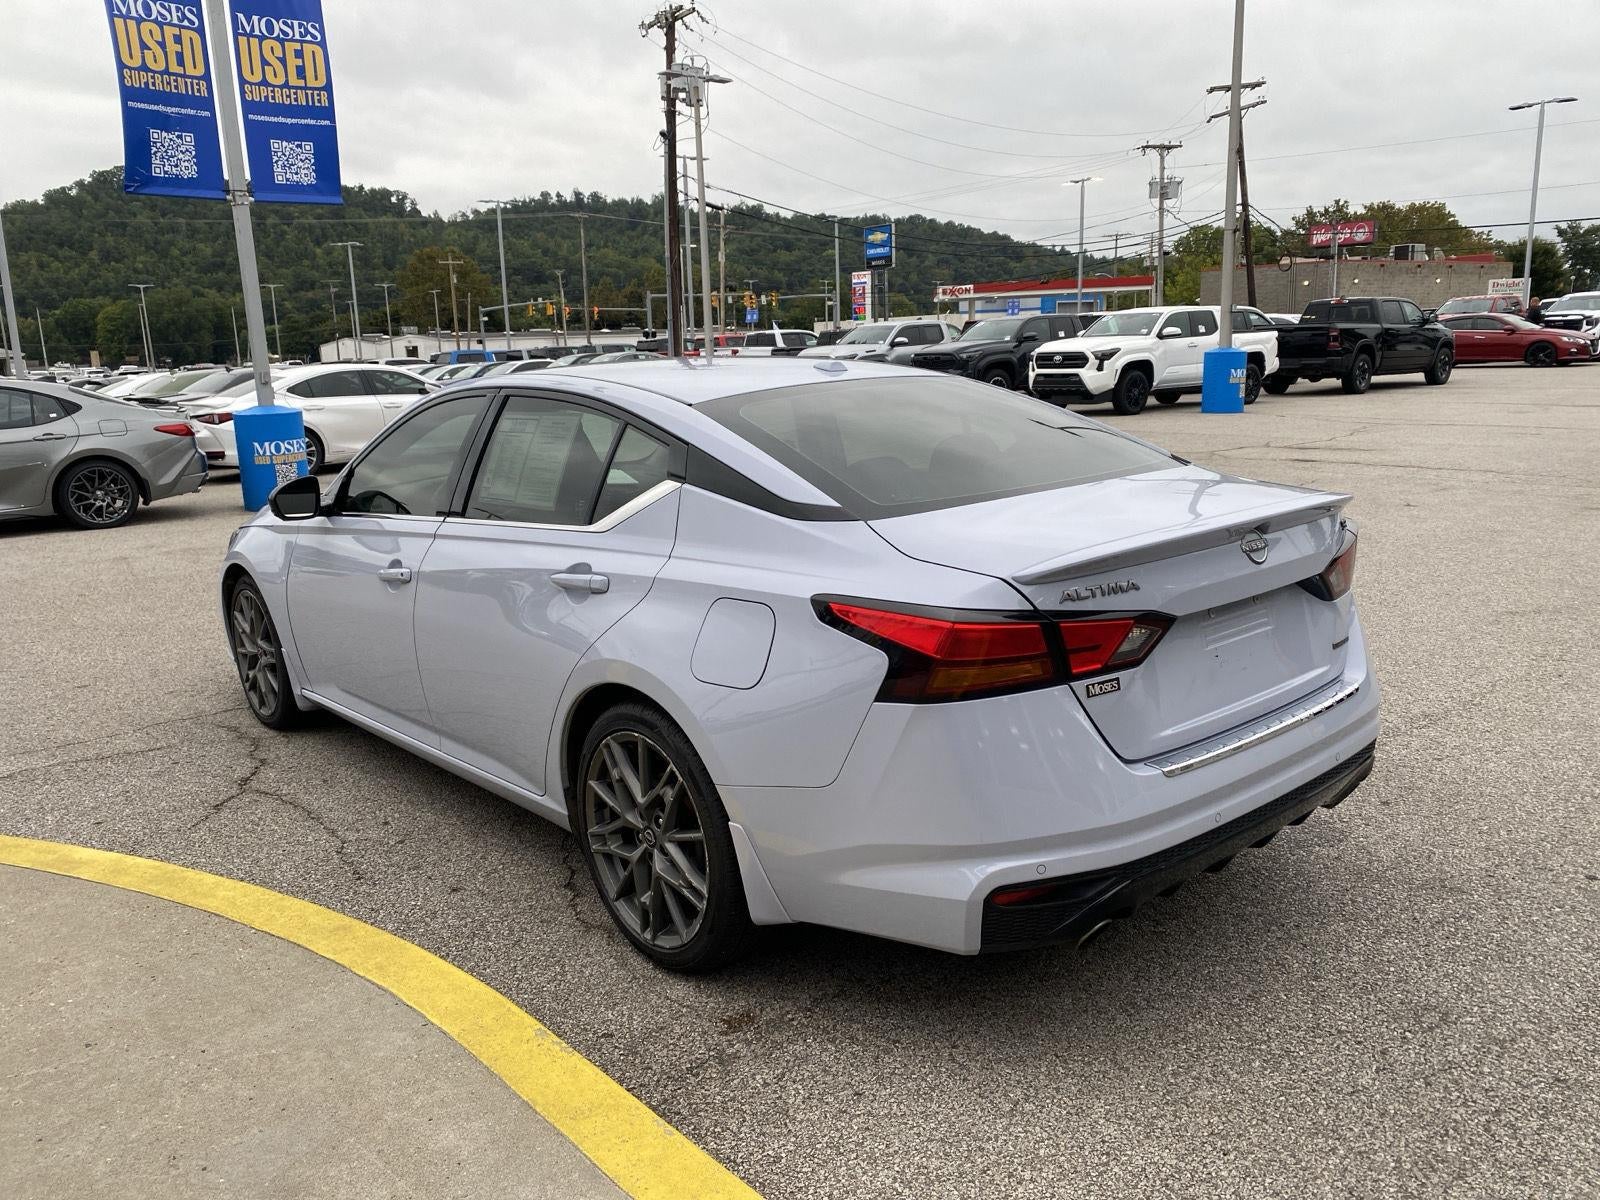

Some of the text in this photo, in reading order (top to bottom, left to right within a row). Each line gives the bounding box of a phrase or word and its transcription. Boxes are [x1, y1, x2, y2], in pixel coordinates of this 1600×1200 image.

[113, 0, 198, 27] MOSES
[236, 13, 321, 42] MOSES
[114, 17, 205, 77] USED
[238, 36, 327, 88] USED
[123, 69, 208, 97] SUPERCENTER
[244, 85, 329, 107] SUPERCENTER
[127, 101, 211, 117] mosesusedsupercenter.com
[248, 113, 331, 126] mosesusedsupercenter.com
[941, 286, 972, 298] EXXON
[253, 439, 305, 456] MOSES
[1059, 580, 1140, 604] ALTIMA
[1088, 681, 1119, 697] MOSES
